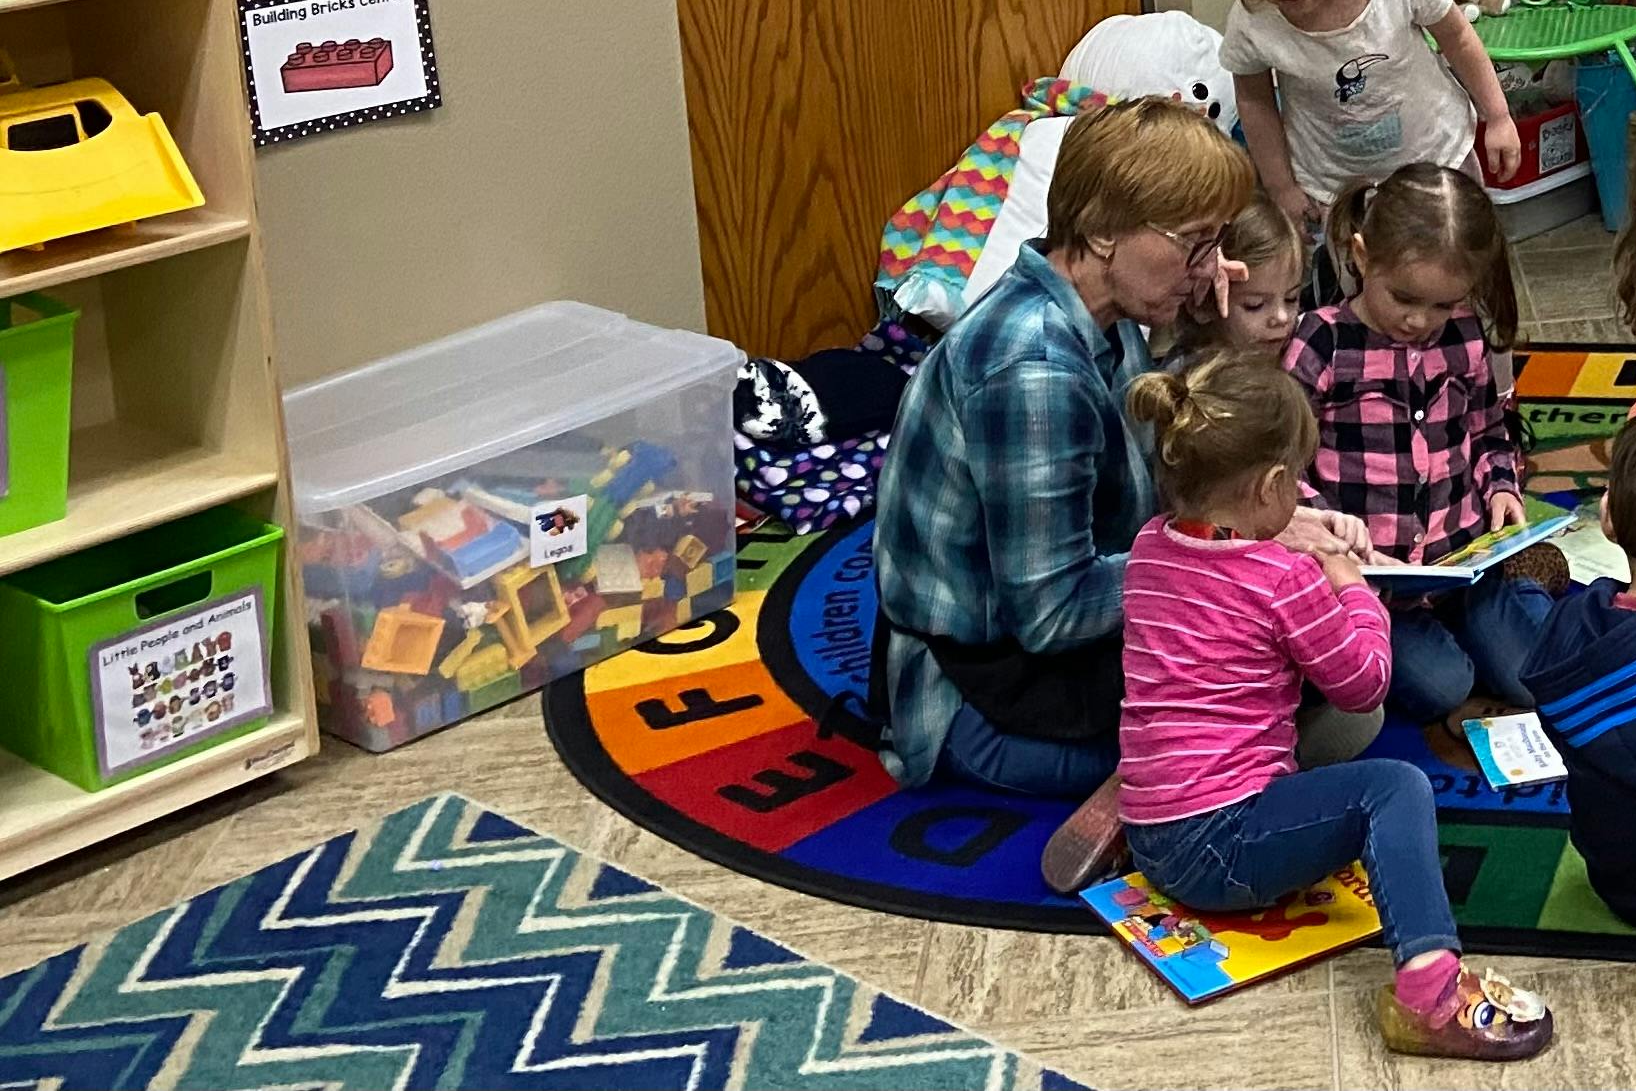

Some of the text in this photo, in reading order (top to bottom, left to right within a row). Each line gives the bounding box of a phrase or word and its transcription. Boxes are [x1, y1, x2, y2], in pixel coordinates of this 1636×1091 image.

[252, 5, 307, 27] Building
[103, 600, 252, 667] Little People and Animals
[634, 687, 764, 730] F
[718, 750, 857, 813] E
[889, 804, 1030, 867] D
